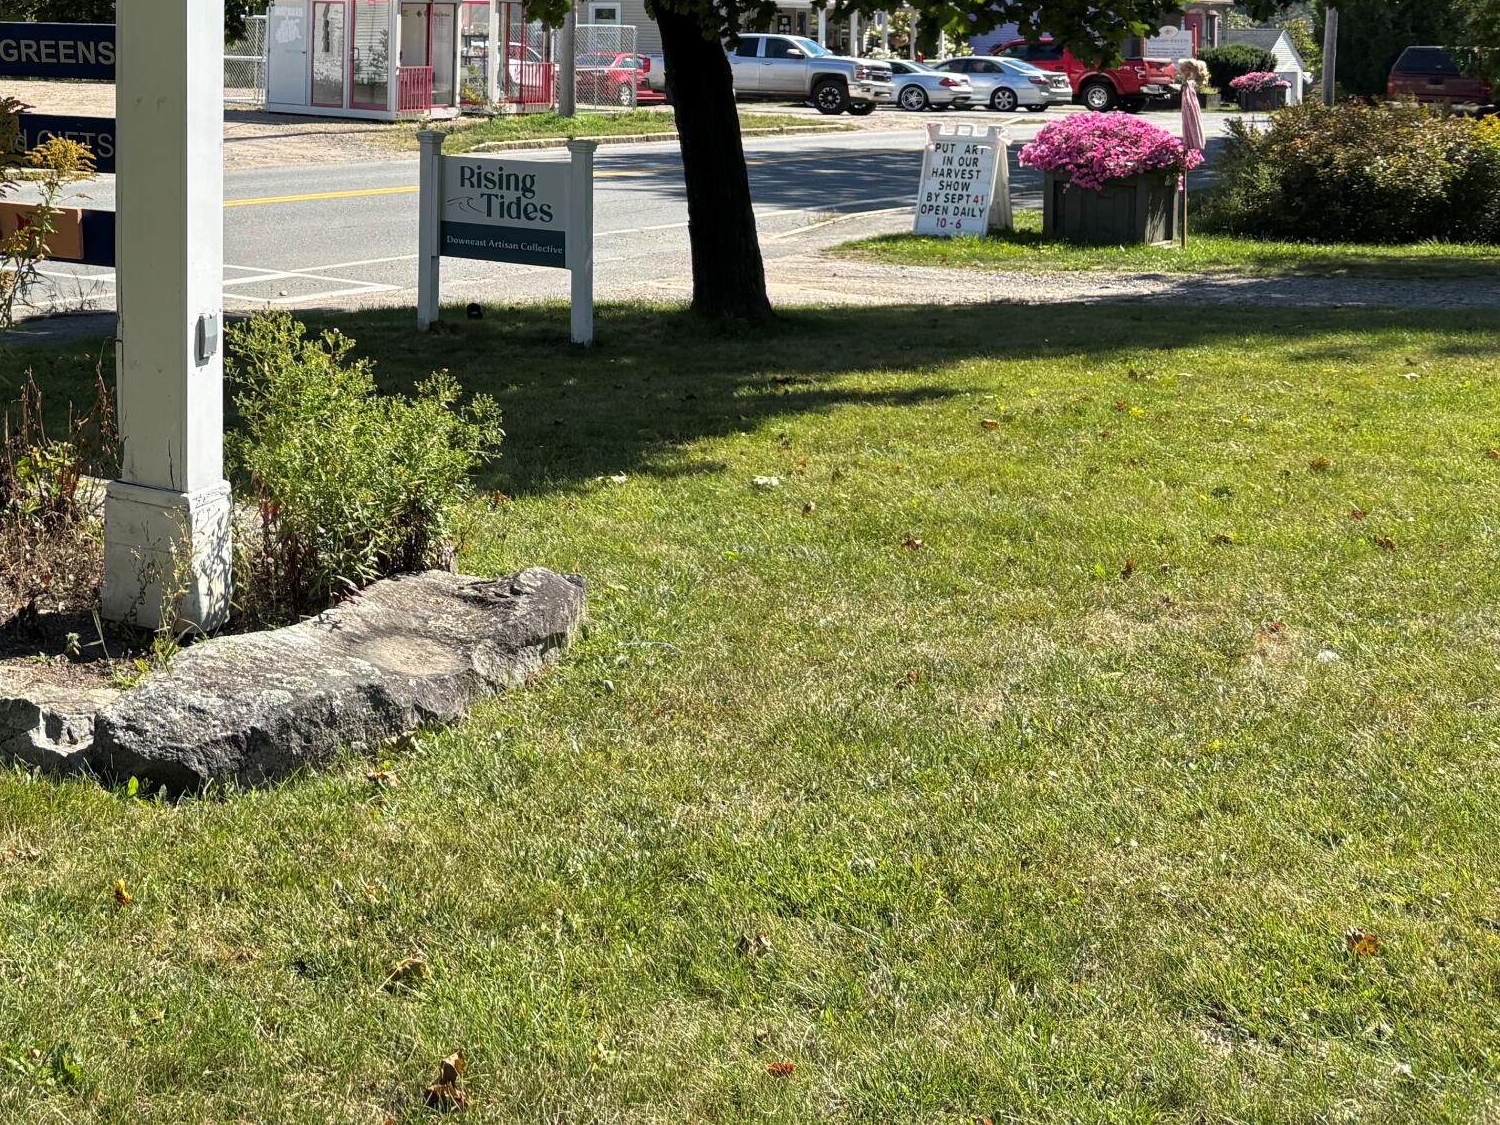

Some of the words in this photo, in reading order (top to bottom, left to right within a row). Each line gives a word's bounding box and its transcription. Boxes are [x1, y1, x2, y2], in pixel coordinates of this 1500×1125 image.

[934, 142, 956, 153] PUT
[942, 156, 953, 166] IN
[958, 156, 979, 167] OUR
[931, 168, 981, 180] HARVEST
[459, 164, 537, 199] Rising
[938, 180, 970, 191] SHOW
[926, 192, 940, 203] BY
[943, 193, 971, 204] SEPT
[480, 192, 553, 223] Tides
[920, 204, 948, 216] OPEN
[953, 206, 985, 218] DAILY
[446, 234, 487, 247] Downeast
[488, 238, 519, 251] Artisan
[520, 241, 564, 255] Collective
